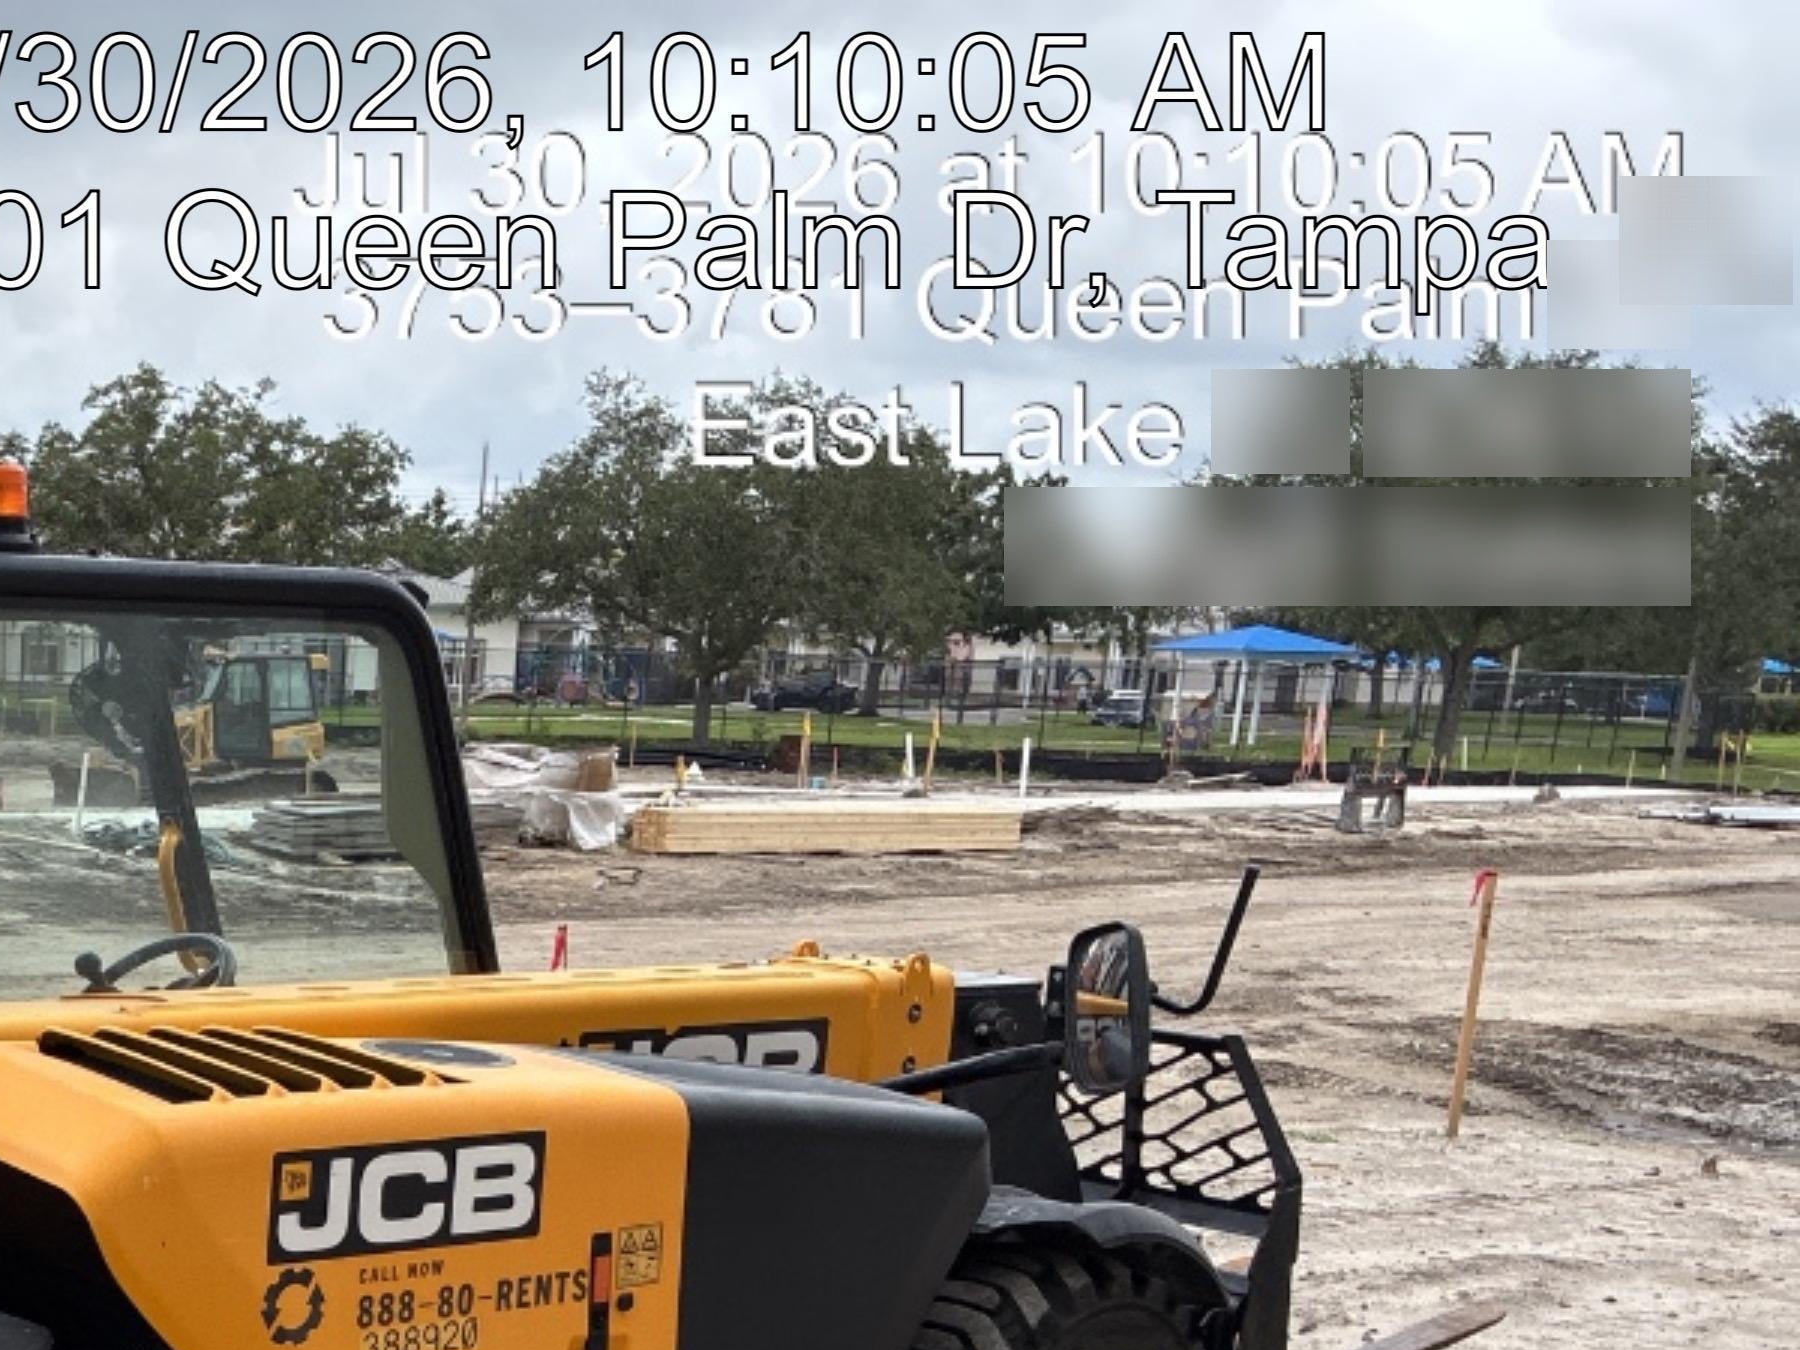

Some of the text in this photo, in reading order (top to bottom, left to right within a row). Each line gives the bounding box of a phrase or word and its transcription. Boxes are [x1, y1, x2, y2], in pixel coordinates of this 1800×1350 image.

[276, 1142, 537, 1253] JCB
[356, 1268, 588, 1330] 888-80-RENTS
[359, 1259, 445, 1285] CALL NOW
